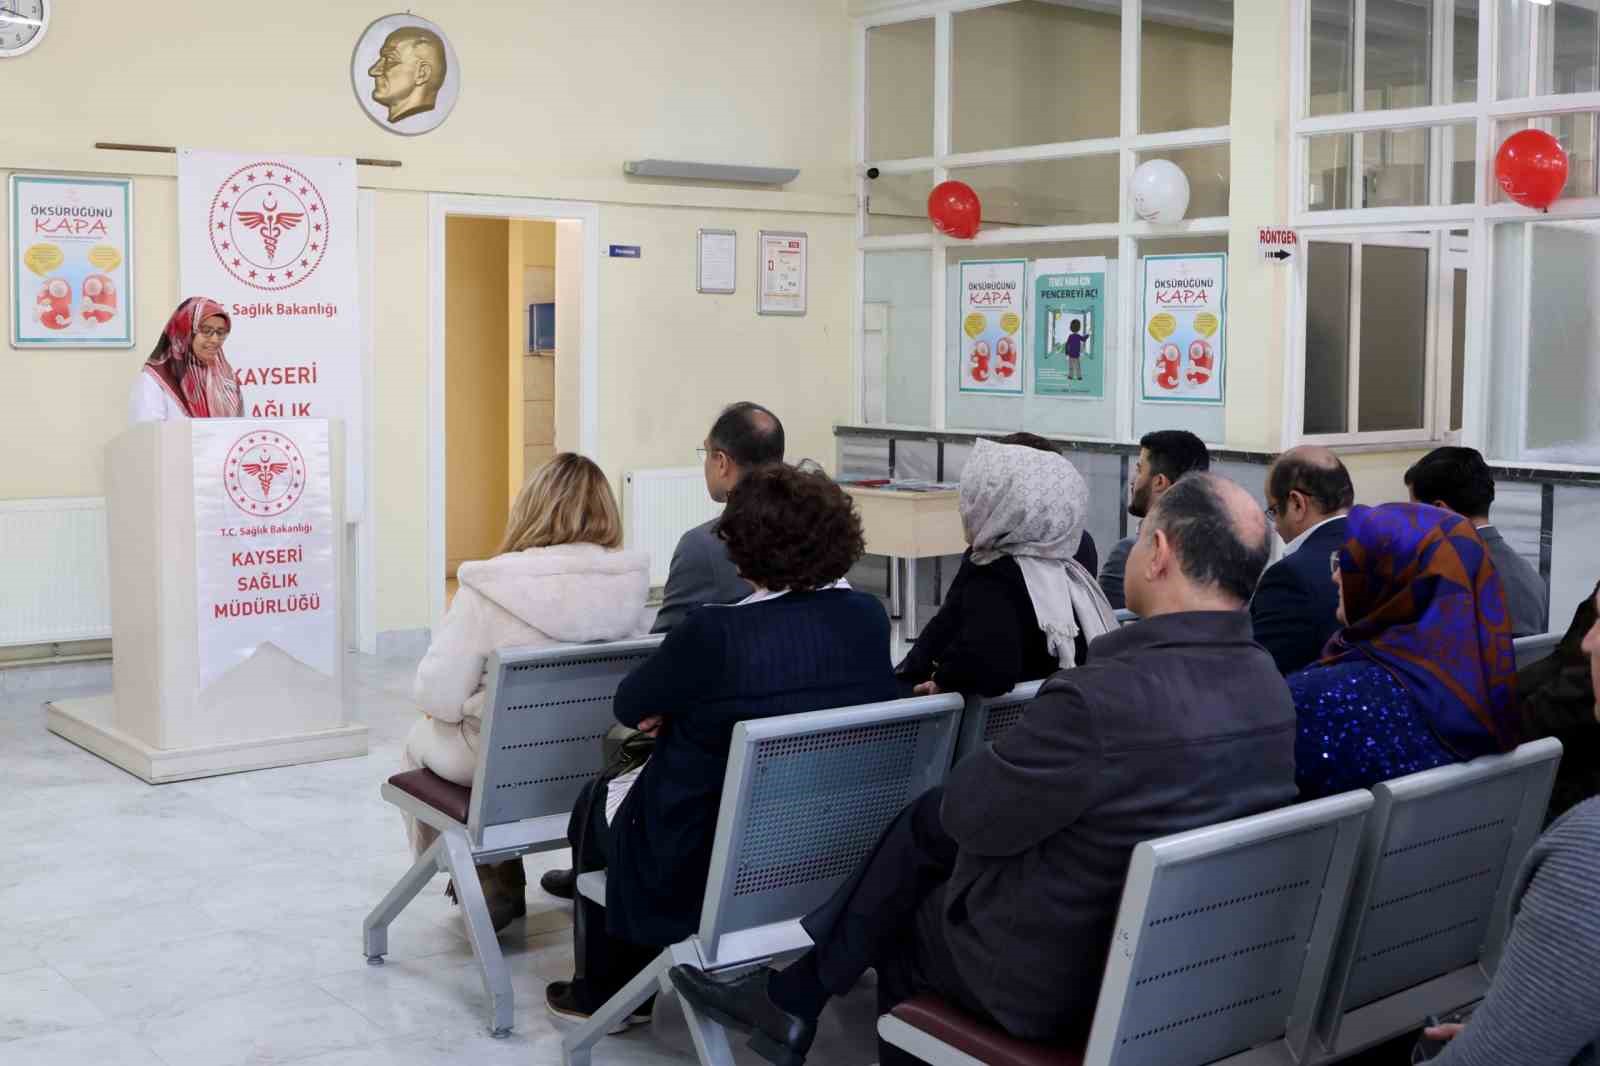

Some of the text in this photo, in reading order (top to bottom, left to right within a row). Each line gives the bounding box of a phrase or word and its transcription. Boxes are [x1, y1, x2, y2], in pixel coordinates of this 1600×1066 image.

[31, 203, 113, 217] ÖKSÜRÜĞÜNÜ
[35, 217, 107, 234] KAPA
[1260, 226, 1297, 244] RÖNTGEN
[969, 291, 1012, 304] KAPA
[1156, 289, 1208, 304] KAPA
[232, 303, 337, 318] Sağlık Bakanlığı
[220, 523, 312, 537] T.C. Sağlık Bakanlığı
[232, 544, 303, 567] KAYSERİ
[238, 572, 298, 592] SAĞLIK
[214, 592, 320, 618] MÜDÜRLÜĞÜ
